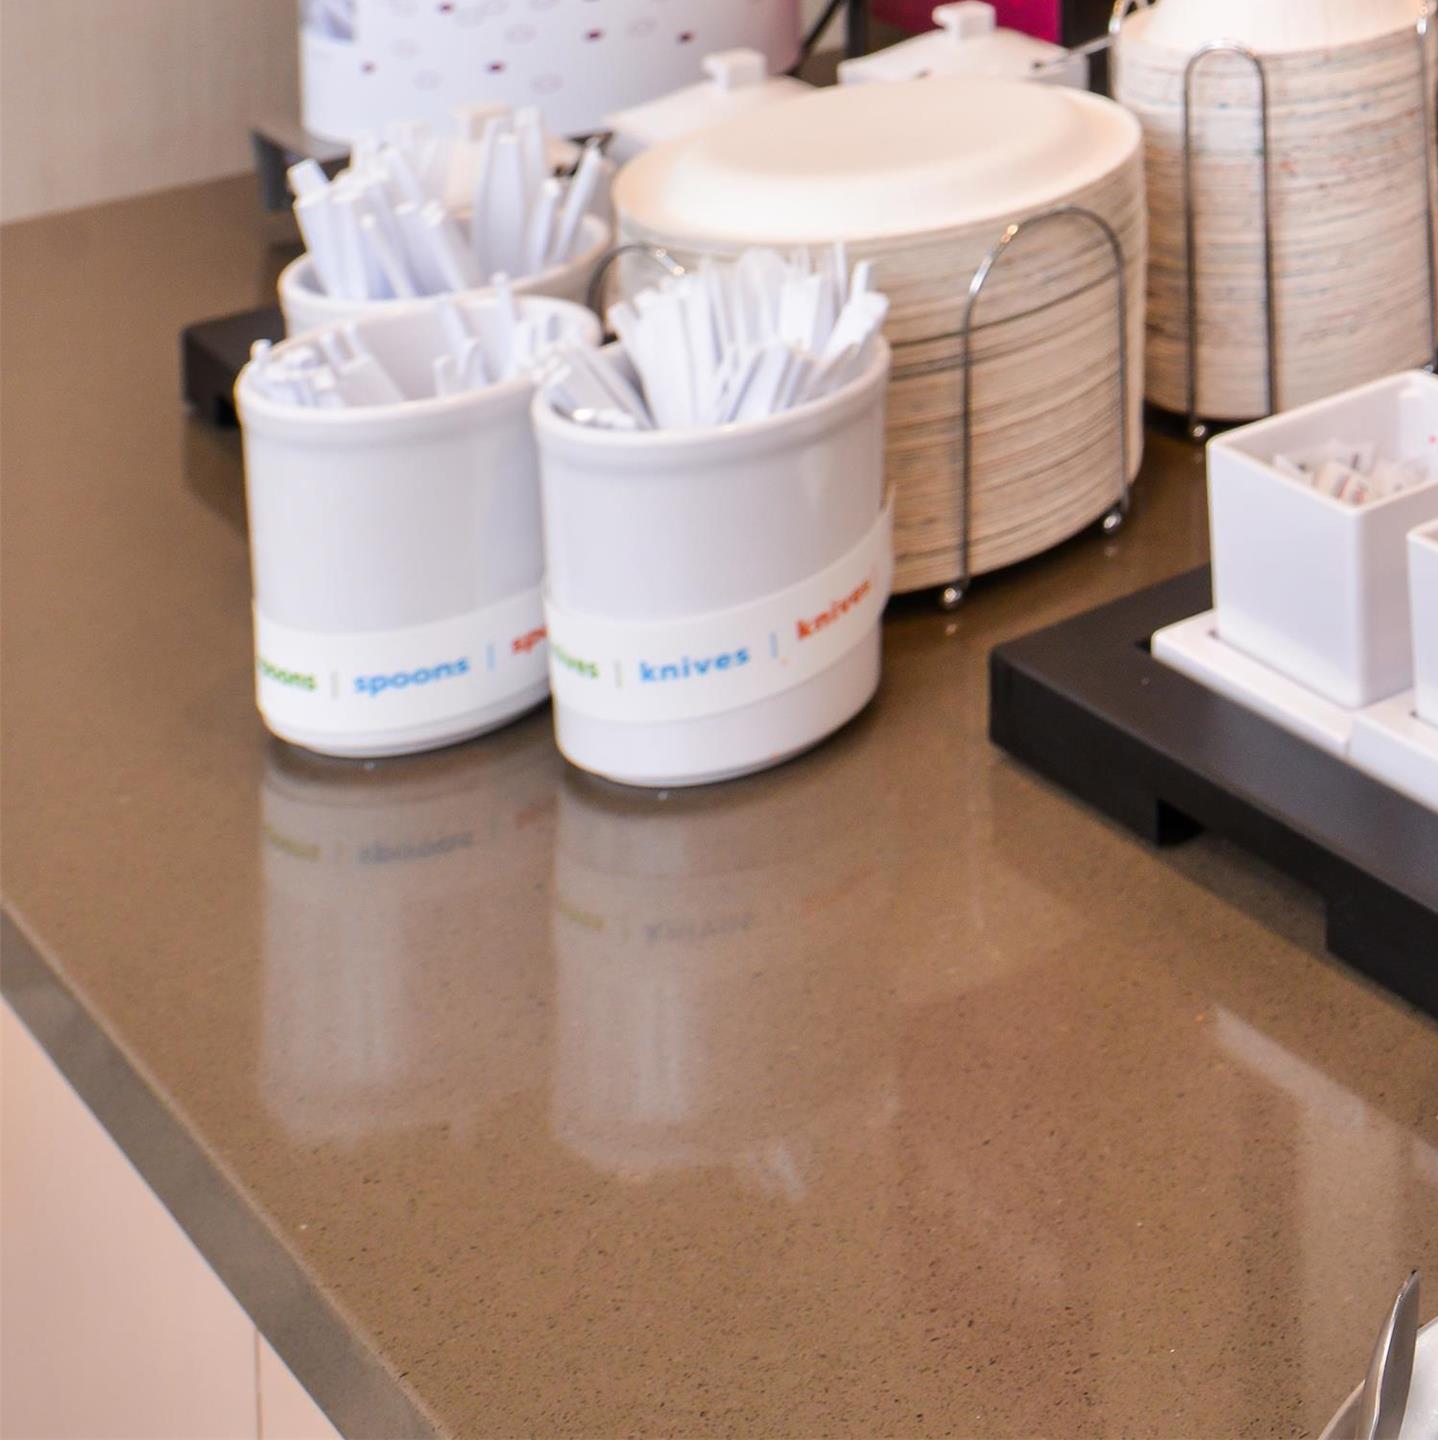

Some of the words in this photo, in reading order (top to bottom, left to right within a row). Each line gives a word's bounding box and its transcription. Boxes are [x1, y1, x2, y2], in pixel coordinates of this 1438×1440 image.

[638, 648, 749, 682] knives
[797, 579, 870, 640] knives
[353, 658, 468, 697] spoons
